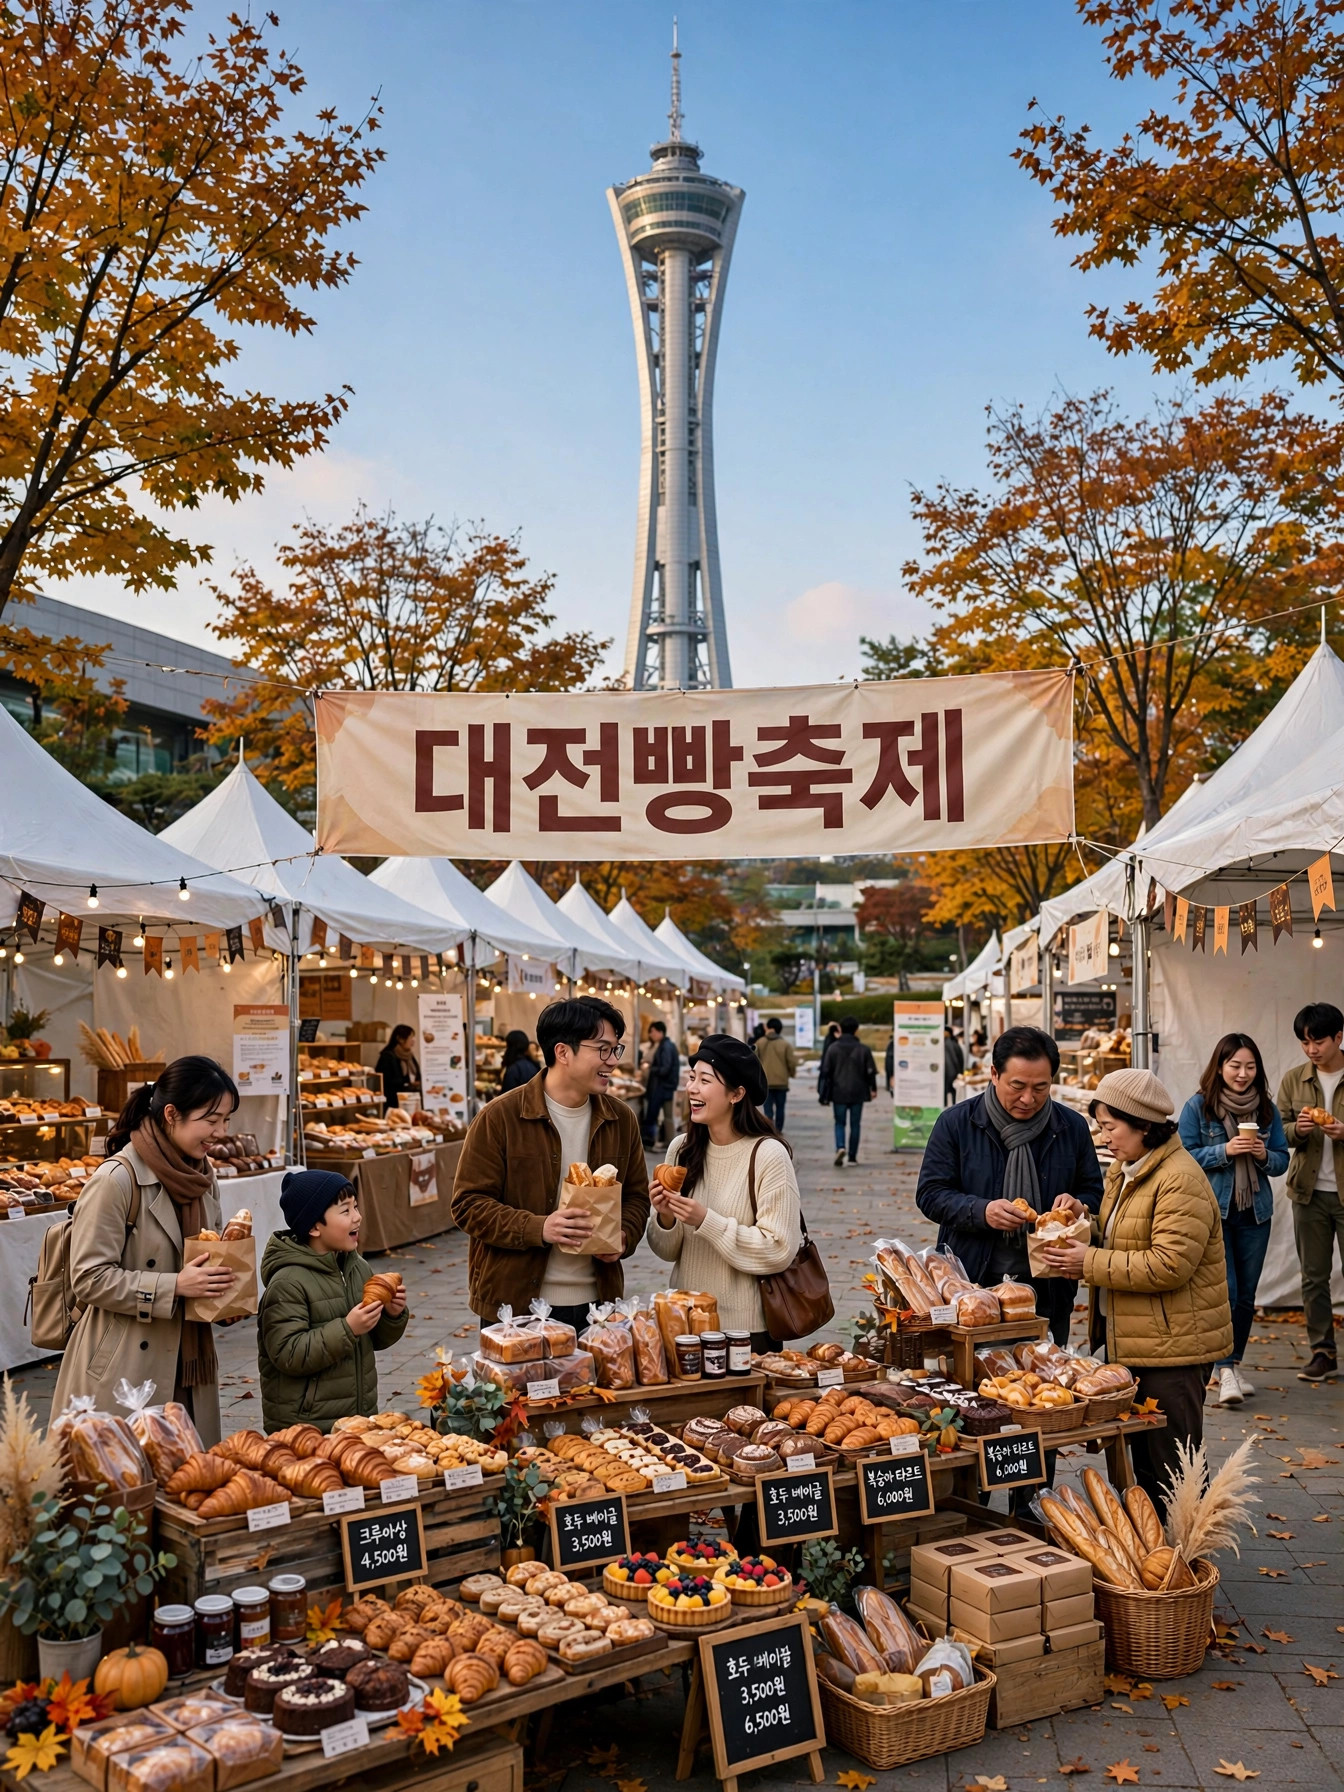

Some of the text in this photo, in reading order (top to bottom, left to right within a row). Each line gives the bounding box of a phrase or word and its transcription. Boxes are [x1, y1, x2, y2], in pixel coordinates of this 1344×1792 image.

[415, 708, 965, 834] 대전빵축제
[868, 1466, 923, 1488] 복숭아 타르트
[996, 1459, 1028, 1478] 6,000원
[769, 1482, 823, 1504] 호두 베이글
[877, 1487, 913, 1507] 6,000원
[564, 1507, 618, 1531] 호두 베이글
[778, 1504, 819, 1526] 3,500원
[360, 1520, 408, 1545] 크루아상
[571, 1530, 612, 1552] 3,500원
[361, 1543, 408, 1570] 4,500원
[726, 1656, 751, 1680] 호두
[740, 1675, 786, 1705] 3,500원
[744, 1703, 791, 1735] 6,500원
